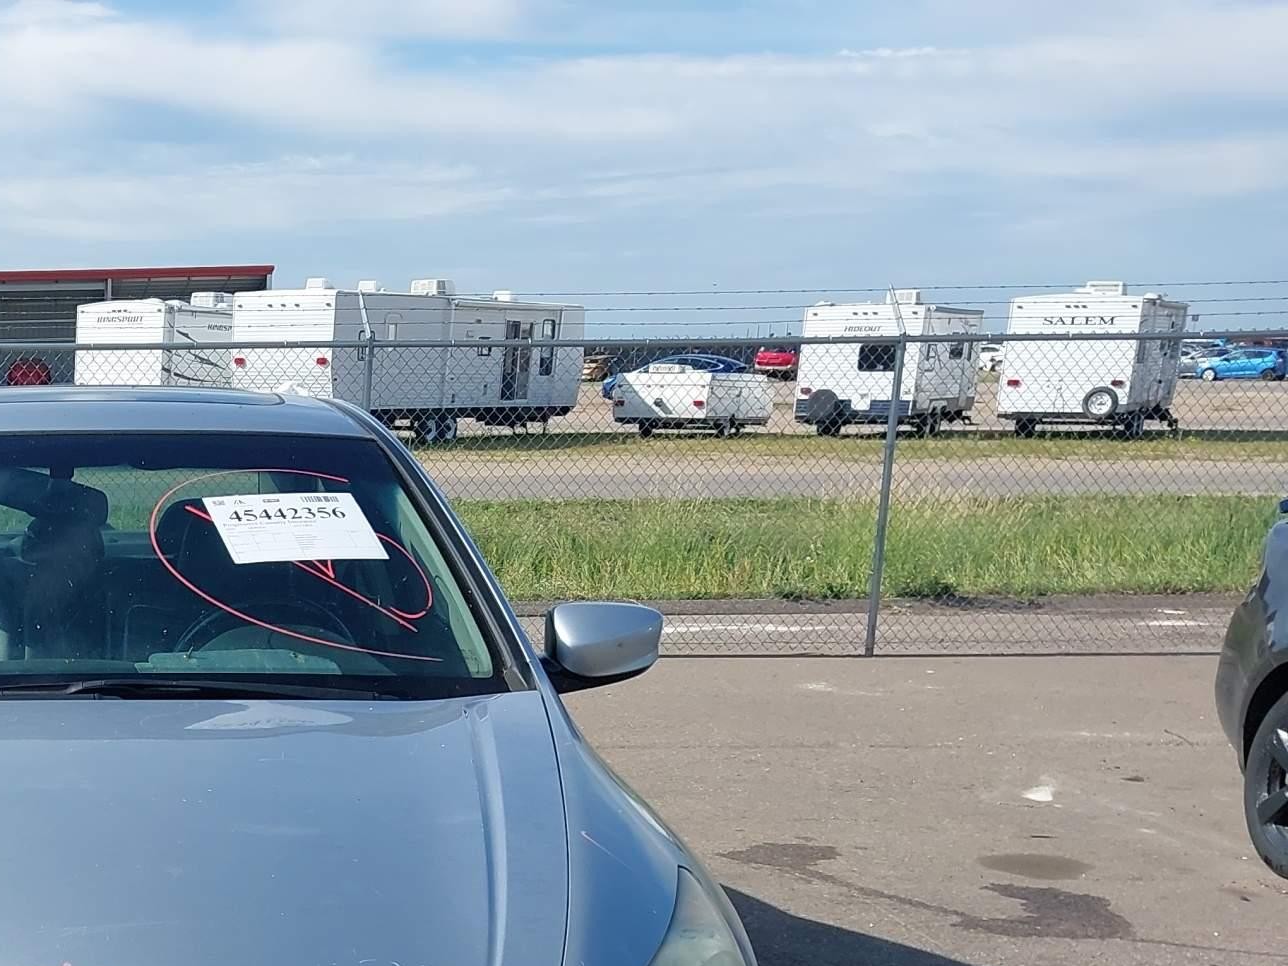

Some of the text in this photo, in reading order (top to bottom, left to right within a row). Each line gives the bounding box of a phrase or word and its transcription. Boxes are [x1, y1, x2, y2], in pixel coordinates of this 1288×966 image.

[1042, 316, 1117, 326] SALEM
[844, 325, 881, 333] HIDEOUT
[229, 507, 346, 522] 45442356
